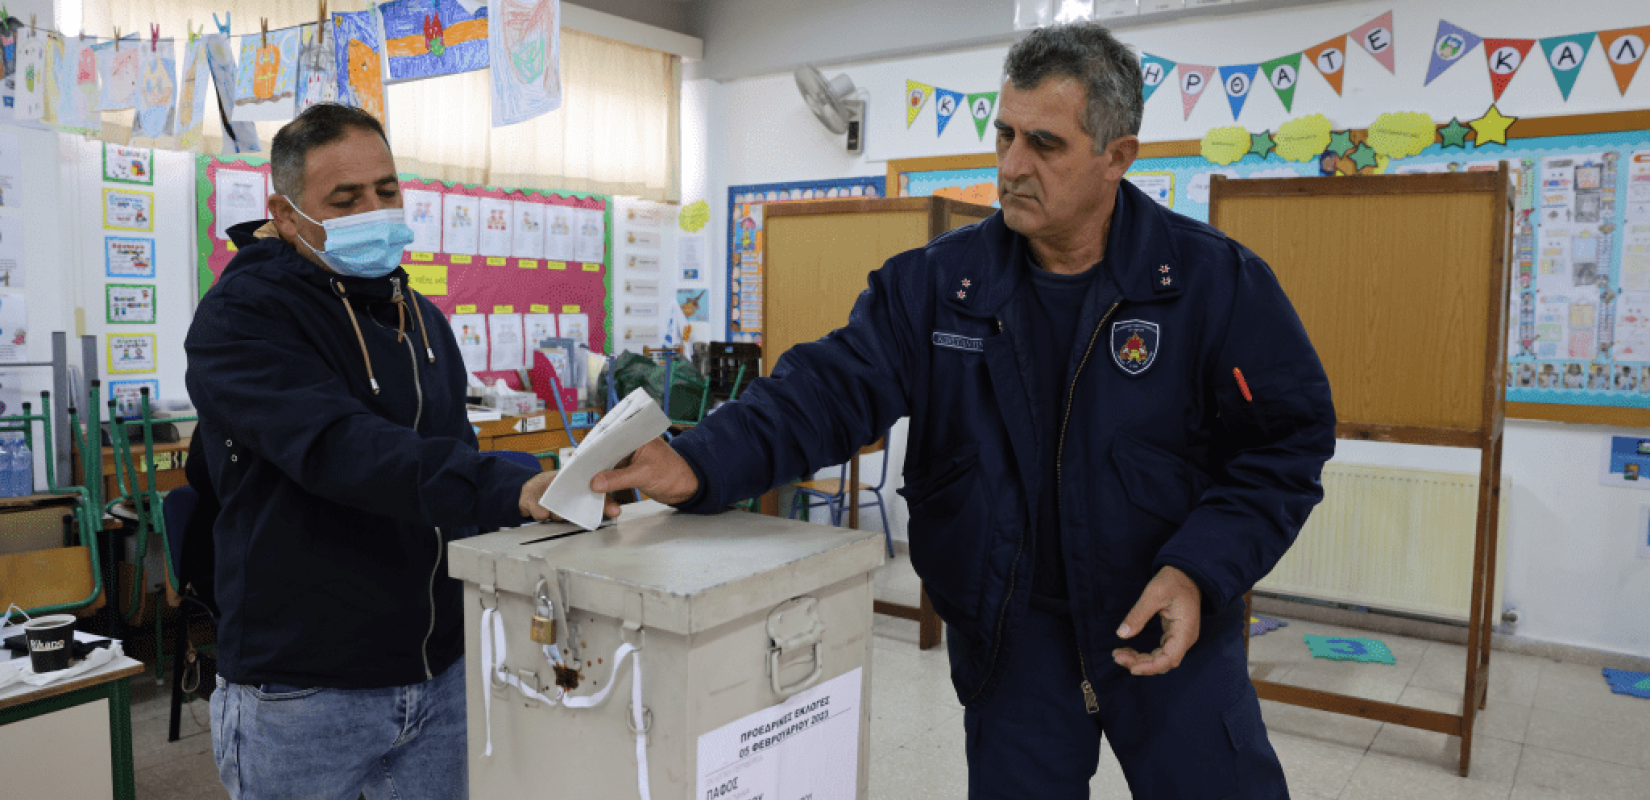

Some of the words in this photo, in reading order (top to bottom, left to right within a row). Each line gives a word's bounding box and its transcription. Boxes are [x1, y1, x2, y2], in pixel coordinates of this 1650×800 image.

[1495, 39, 1636, 71] ΚΑΛ
[794, 695, 830, 718] ΕΚΛΟΓΕΣ
[739, 746, 749, 758] 05
[752, 718, 809, 751] ΦΕΒΡΟΥΑΡΙΟΥ
[811, 709, 829, 724] 2023
[707, 777, 738, 800] ΠΑΦΟΣ
